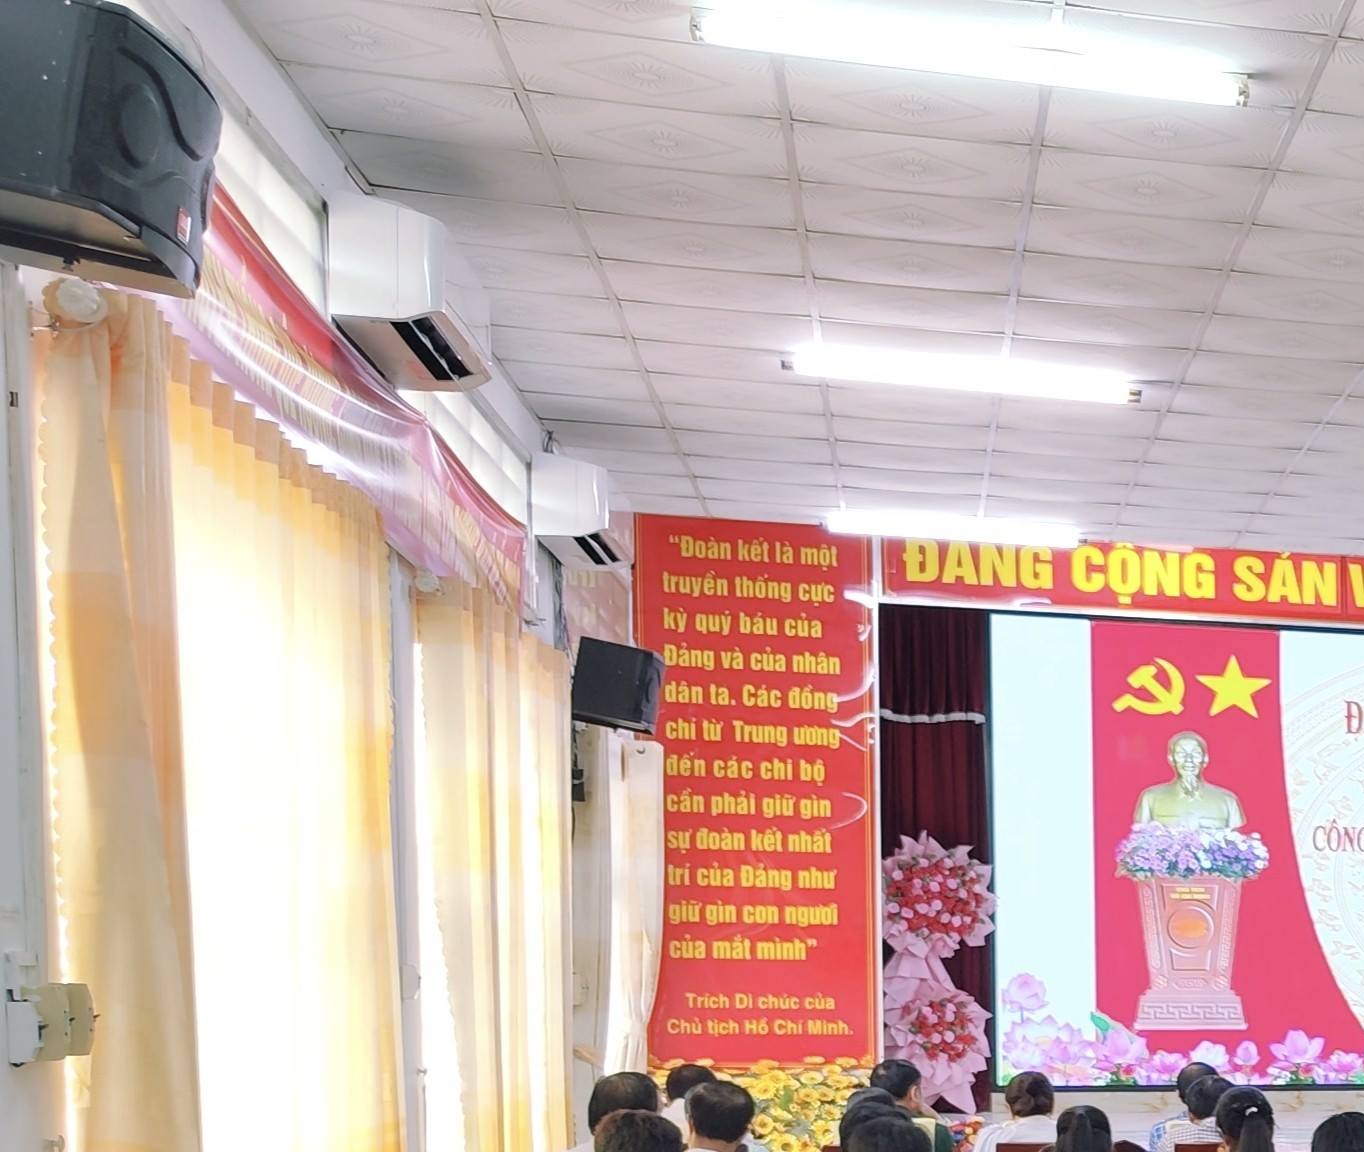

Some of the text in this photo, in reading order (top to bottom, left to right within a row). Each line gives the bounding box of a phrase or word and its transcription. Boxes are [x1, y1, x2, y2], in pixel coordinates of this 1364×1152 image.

[738, 537, 770, 563] kết
[775, 541, 794, 564] là
[800, 544, 838, 571] một
[663, 570, 835, 606] truyền thống cực
[1071, 542, 1216, 605] CỘNG
[663, 607, 822, 638] kỳ quý báu của
[663, 642, 840, 674] Đảng và của nhân
[664, 681, 838, 713] dân ta. Các đồng
[702, 718, 724, 741] từ
[732, 720, 788, 747] Trung
[793, 725, 840, 748] ương
[666, 751, 825, 786] đến các chi bộ
[666, 787, 831, 819] cần phải giữ gìn
[667, 827, 832, 854] sự đoàn kết nhất
[697, 862, 734, 887] của
[740, 863, 792, 890] Đảng
[798, 867, 838, 889] như
[669, 900, 702, 924] giữ
[705, 900, 736, 925] gìn
[743, 904, 779, 924] con
[669, 934, 706, 959] của
[712, 934, 751, 960] mắt
[685, 993, 835, 1010] Trích Di chúc của
[667, 1017, 854, 1037] Chủ tịch Hồ Chí Minh.
